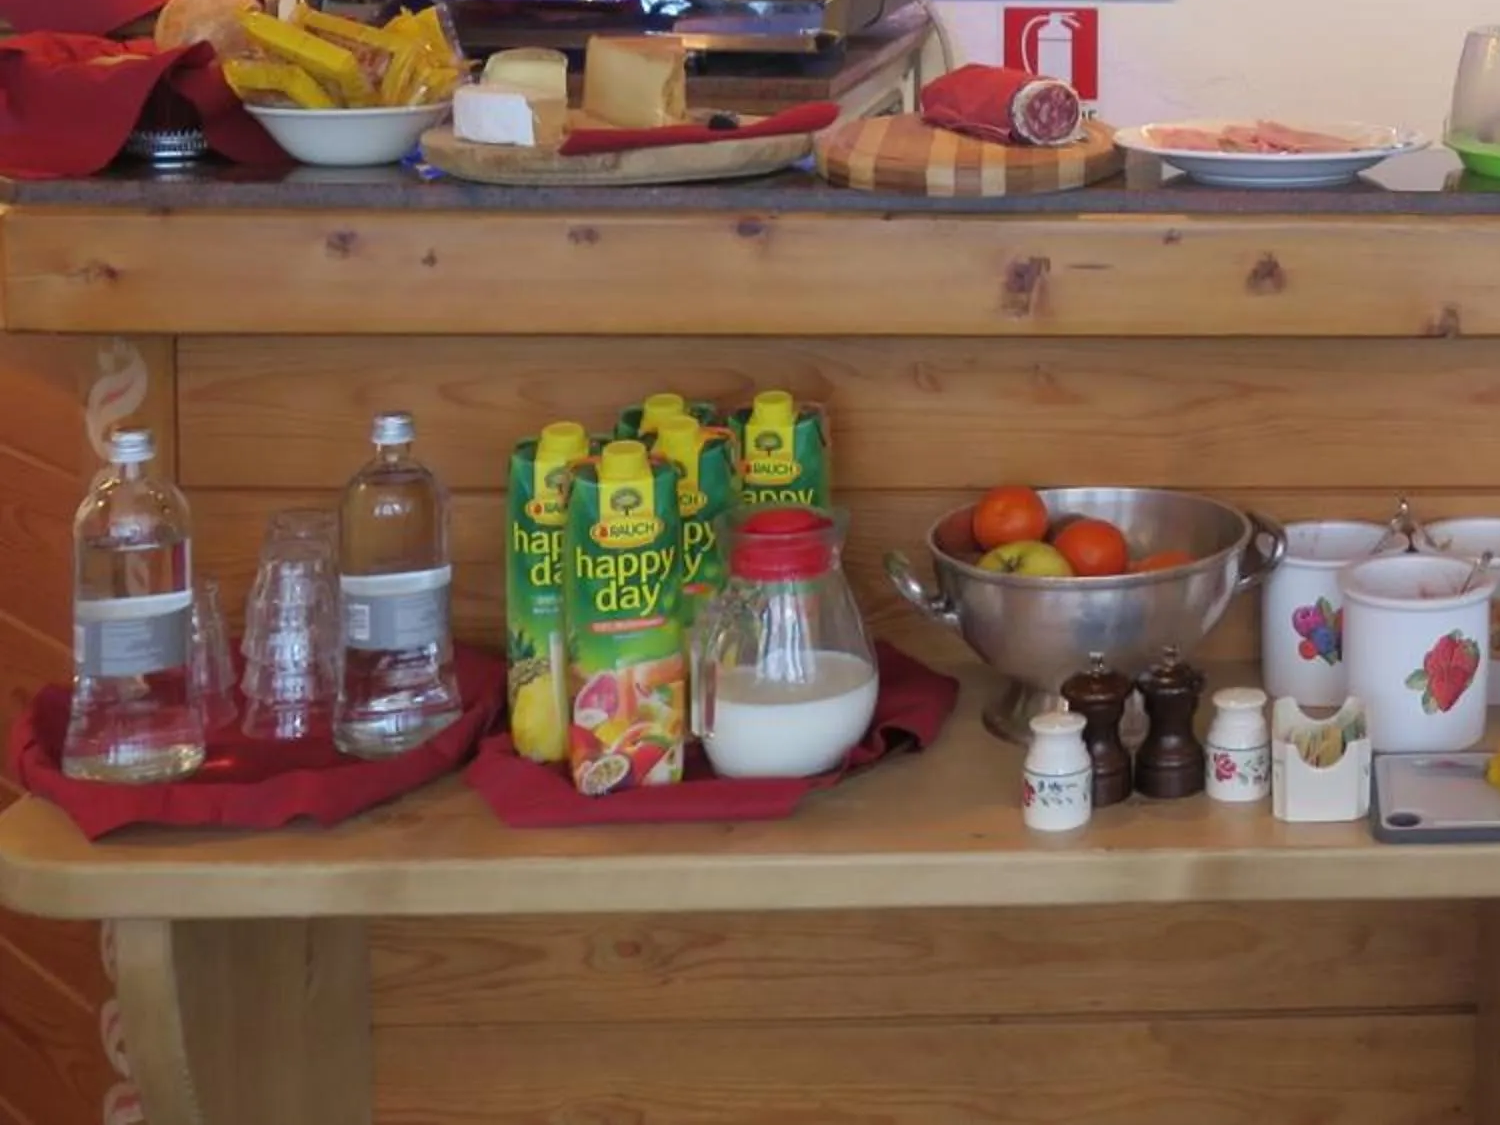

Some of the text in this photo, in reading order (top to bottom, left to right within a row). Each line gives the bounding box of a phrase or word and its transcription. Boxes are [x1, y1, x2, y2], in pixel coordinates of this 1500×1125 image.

[743, 488, 815, 505] appy
[513, 521, 564, 562] hap
[609, 521, 656, 536] RAUCH
[575, 545, 675, 586] happy
[595, 579, 661, 617] day
